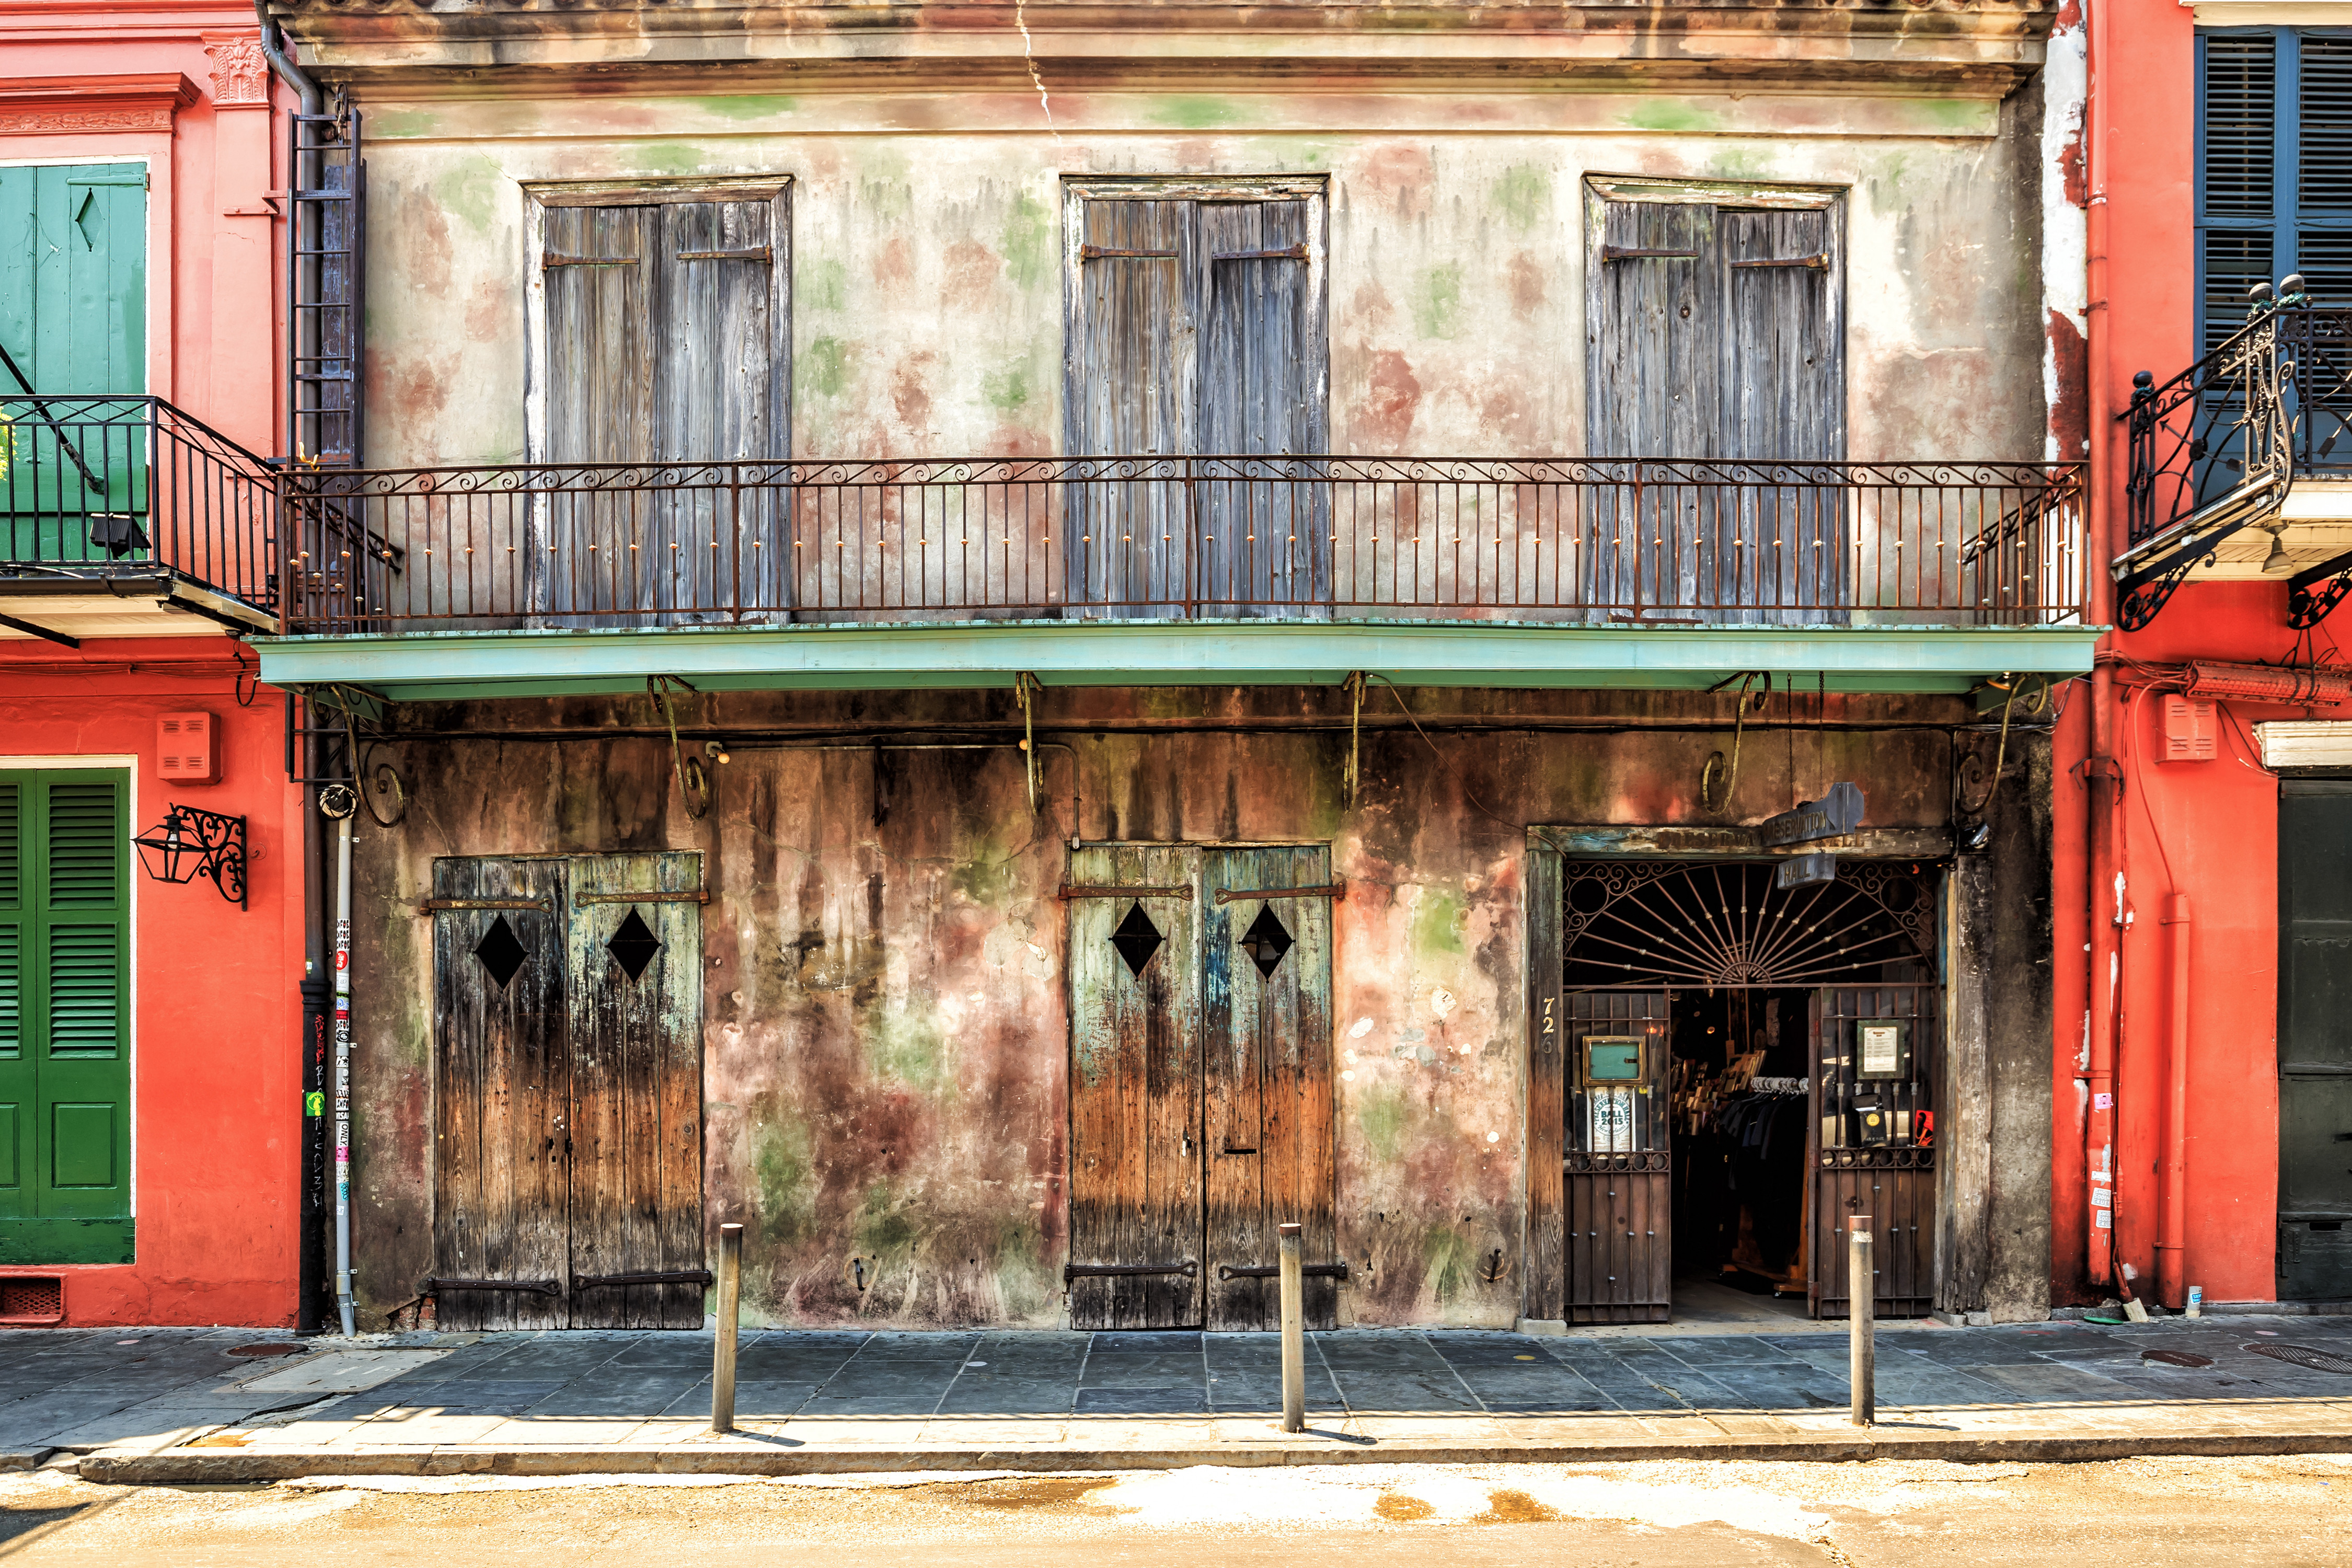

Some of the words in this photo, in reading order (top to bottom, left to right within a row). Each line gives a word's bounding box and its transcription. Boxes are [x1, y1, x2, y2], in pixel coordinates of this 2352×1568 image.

[1762, 811, 1827, 839] PRESERVATION
[1784, 860, 1810, 883] HALL
[340, 1124, 348, 1146] ONLY.
